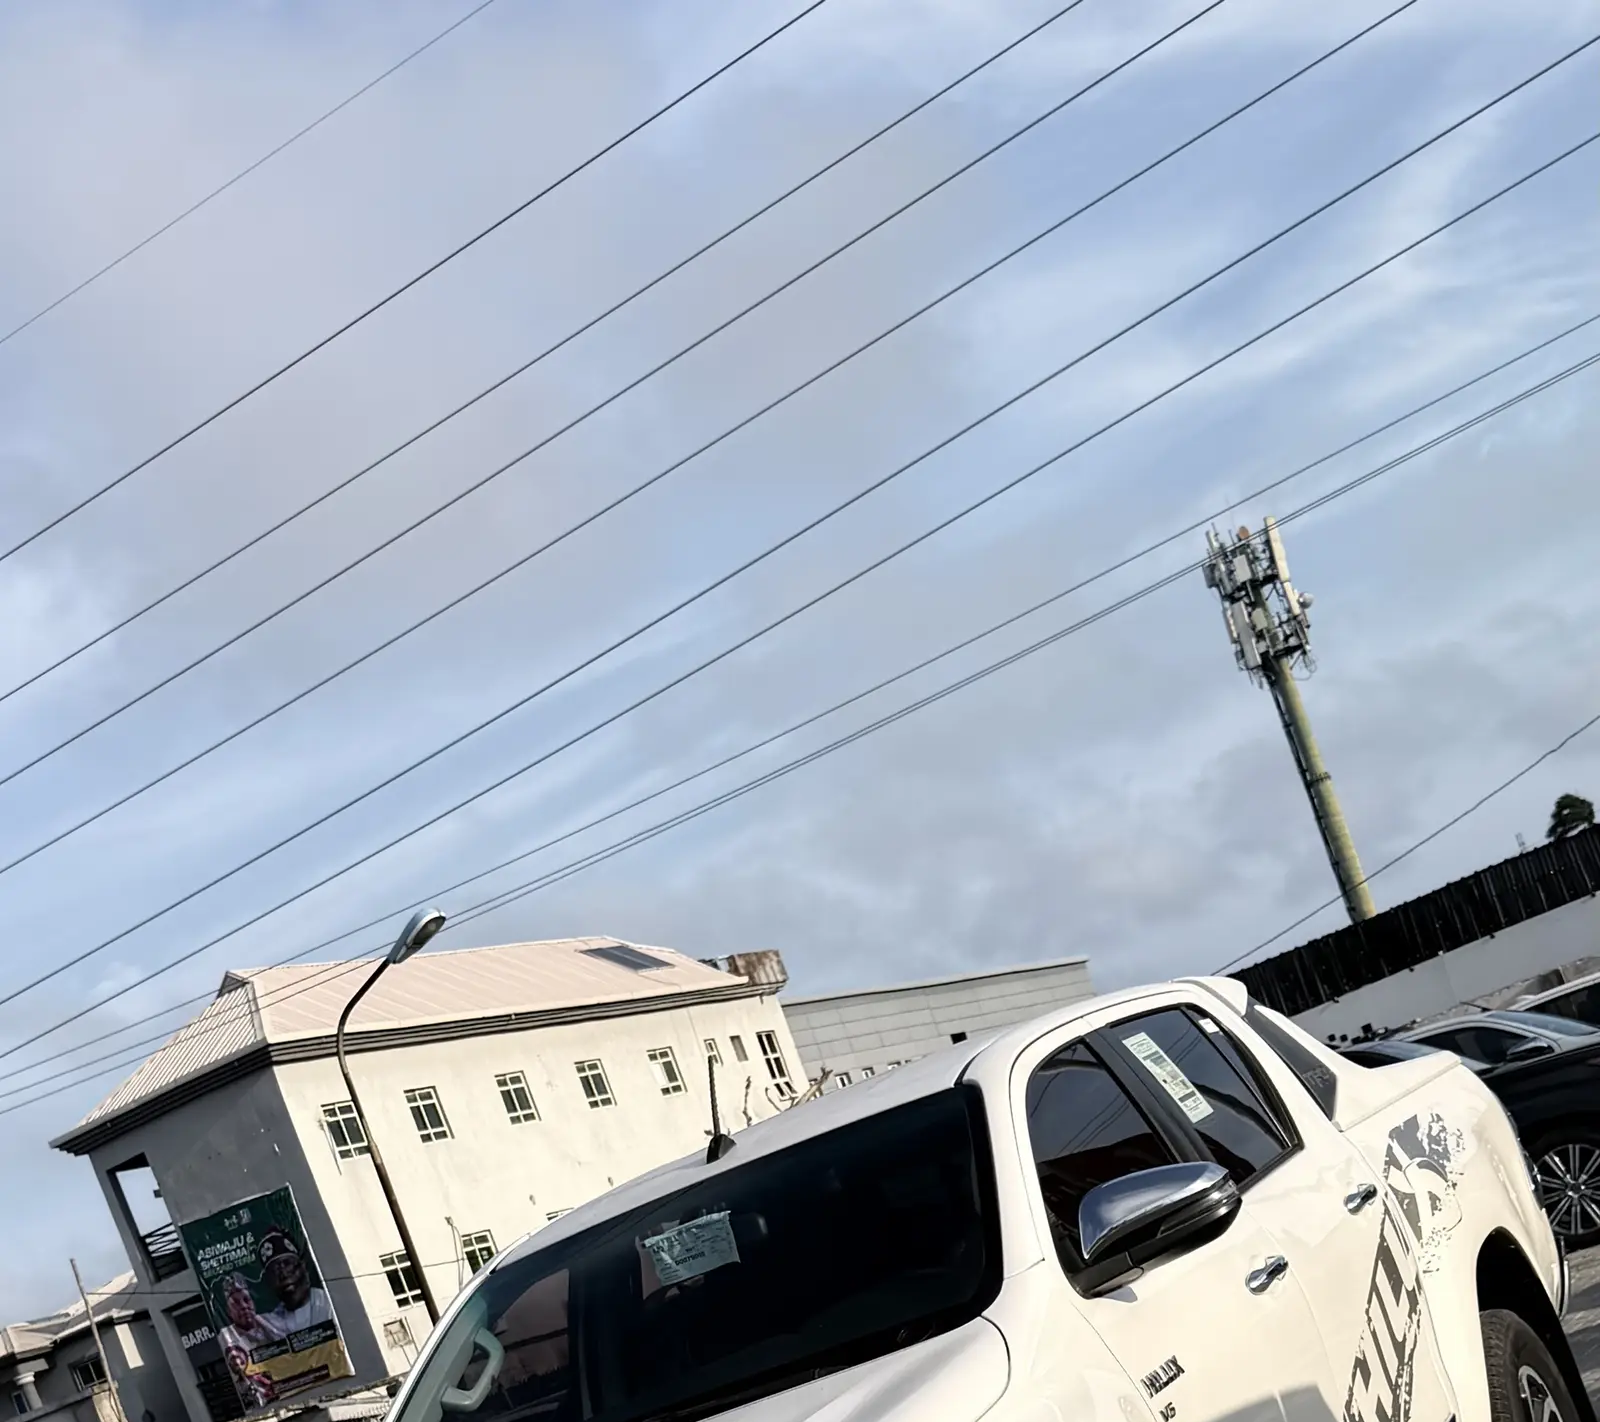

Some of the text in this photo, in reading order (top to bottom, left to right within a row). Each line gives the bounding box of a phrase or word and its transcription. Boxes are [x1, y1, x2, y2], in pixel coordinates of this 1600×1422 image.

[197, 1235, 244, 1261] ASIWAJU
[246, 1232, 255, 1243] &
[200, 1247, 247, 1270] SHETTIMA
[181, 1326, 215, 1349] BARR.
[1140, 1355, 1185, 1399] HILUX
